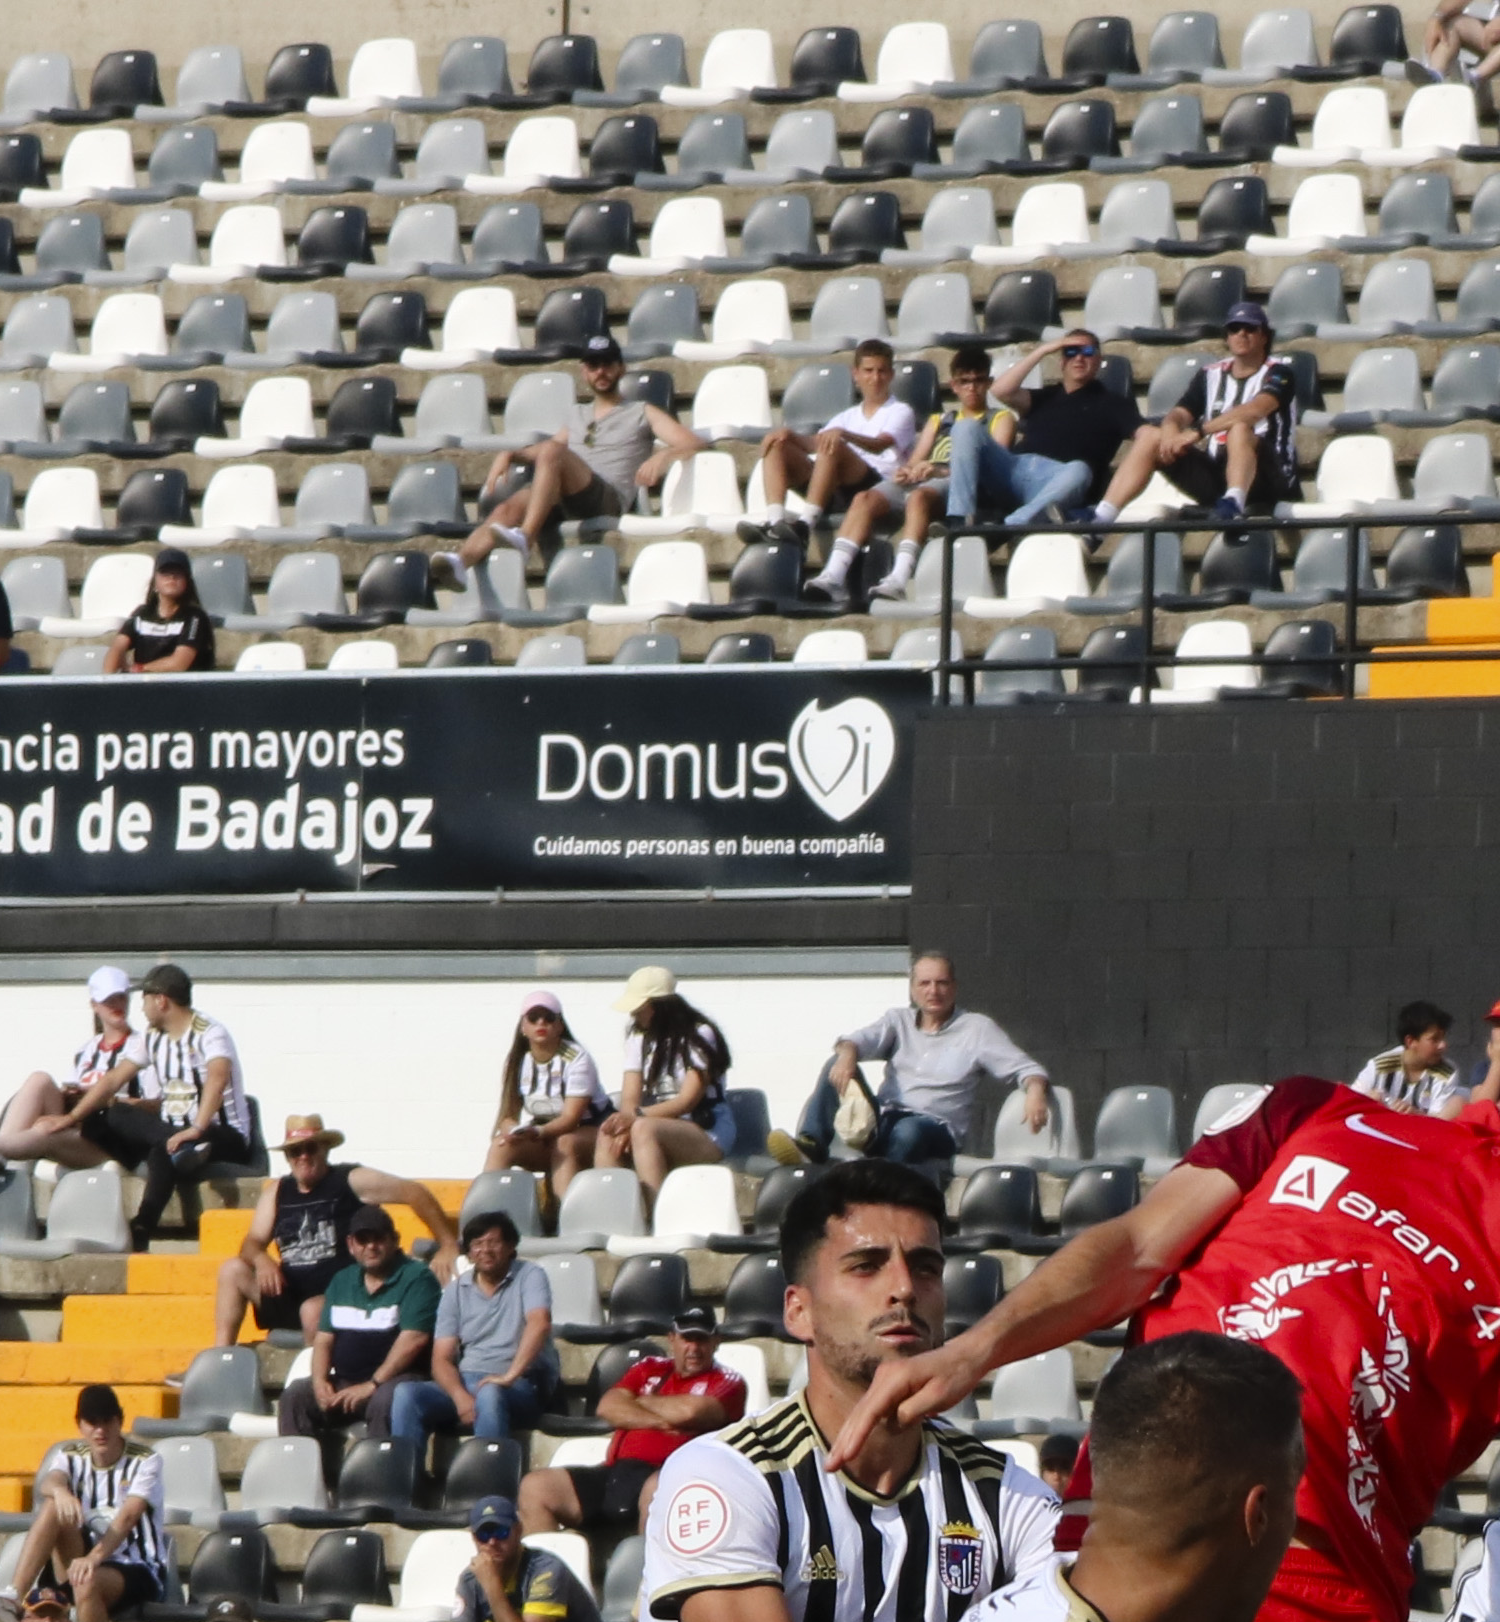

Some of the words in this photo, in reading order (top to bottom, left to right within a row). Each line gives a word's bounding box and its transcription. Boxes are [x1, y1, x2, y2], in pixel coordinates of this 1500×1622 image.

[94, 732, 193, 787] para
[209, 722, 405, 778] mayores
[76, 792, 153, 852] de
[174, 785, 434, 866] Badajoz
[533, 836, 622, 857] Cuidamos
[625, 839, 710, 858] personas
[715, 840, 738, 856] en
[742, 836, 796, 856] buena
[800, 833, 885, 857] compañía
